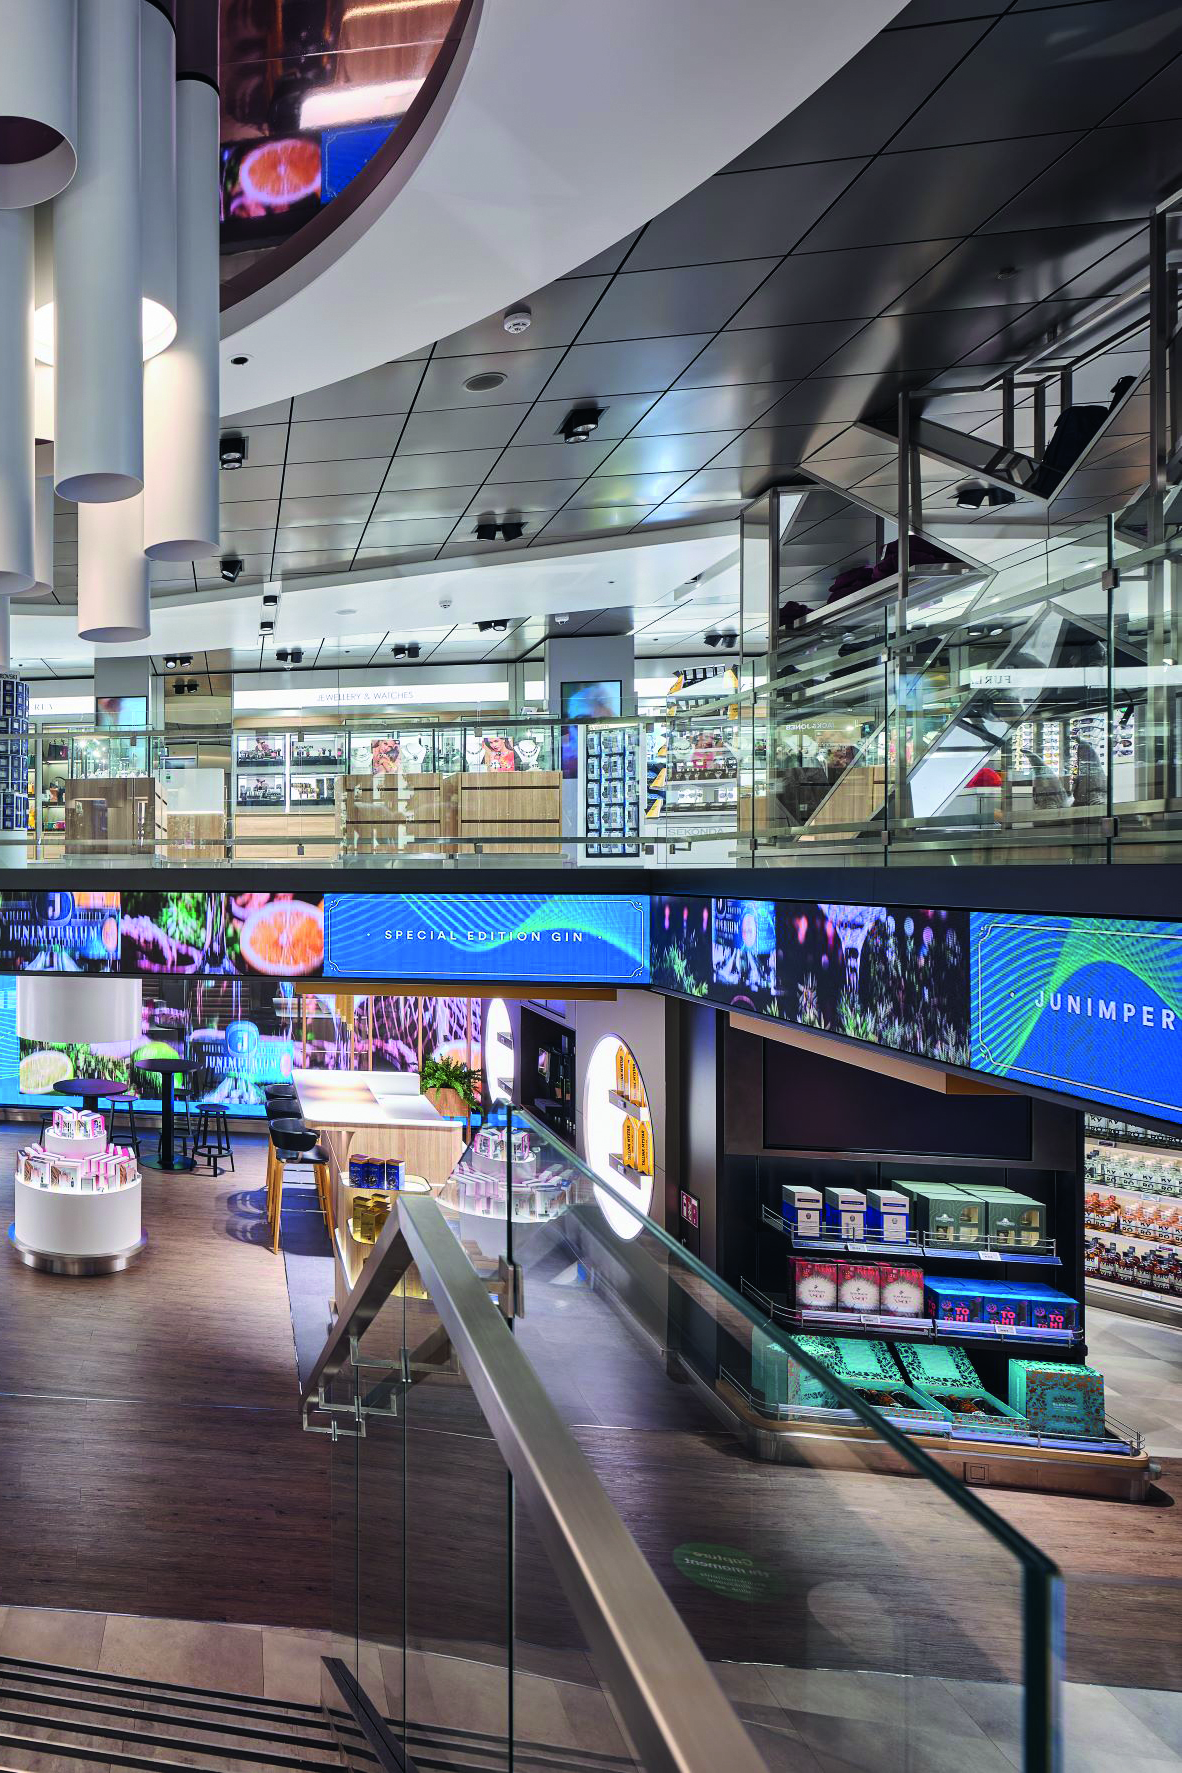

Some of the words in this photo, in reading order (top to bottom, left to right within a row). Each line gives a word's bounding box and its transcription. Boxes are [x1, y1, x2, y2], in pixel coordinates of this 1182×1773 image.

[317, 693, 361, 702] JEWELLERY
[373, 691, 414, 700] WATCHES
[384, 929, 458, 941] SPECIAL
[467, 931, 541, 942] EDITION
[551, 932, 583, 942] GIN
[955, 1307, 970, 1315] TO
[1001, 1310, 1016, 1318] TO
[1049, 1314, 1064, 1322] TO
